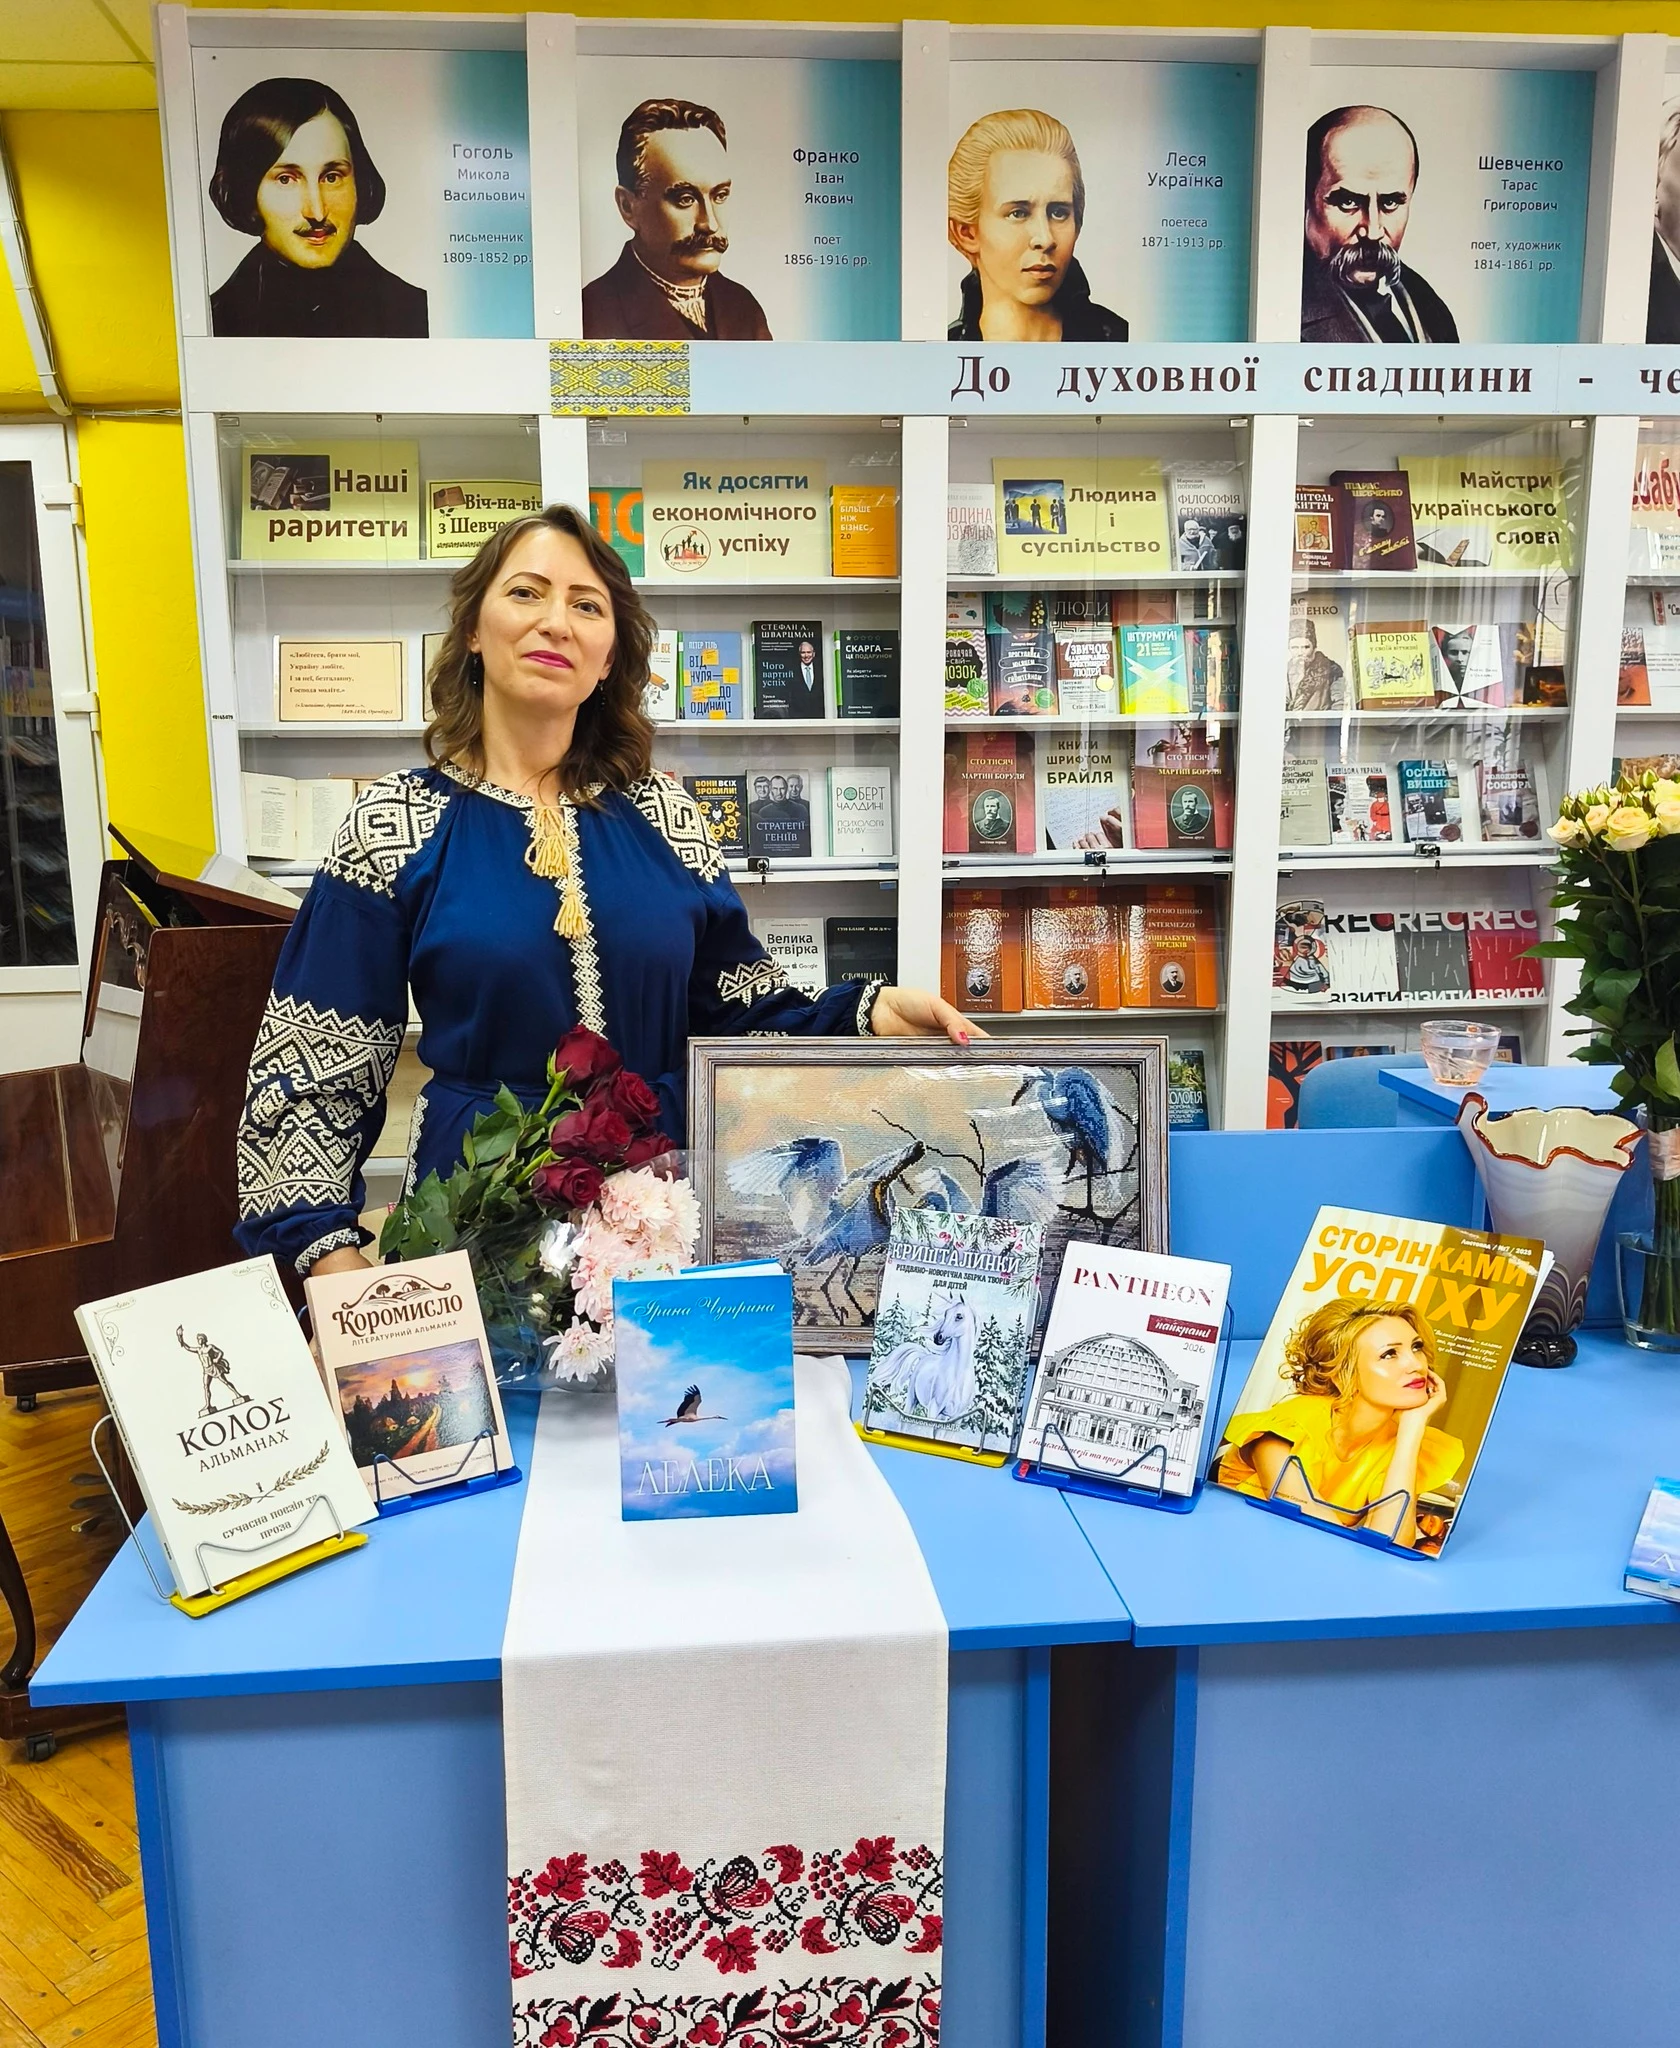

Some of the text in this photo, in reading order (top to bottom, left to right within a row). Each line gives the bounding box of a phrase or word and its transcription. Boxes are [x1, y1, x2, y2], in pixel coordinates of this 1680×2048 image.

[453, 144, 513, 159] Гоголь
[793, 148, 860, 166] Франко
[1165, 152, 1206, 167] Леся
[1479, 156, 1564, 171] Шевченко
[458, 168, 510, 180] Микола
[815, 172, 844, 184] Іван
[1147, 172, 1223, 190] Українка
[1501, 179, 1538, 192] Тарас
[444, 189, 526, 201] Васильович
[805, 192, 854, 204] Якович
[1484, 199, 1558, 212] Григорович
[1161, 219, 1208, 228] поетеса
[449, 233, 524, 242] письменник
[814, 236, 841, 245] поет
[1142, 237, 1227, 250] 1871-1913 рр.
[1471, 241, 1562, 252] поет, художник
[443, 252, 532, 265] 1809-1852 рр.
[784, 254, 871, 267] 1856-1916 рр.
[1474, 259, 1556, 272] 1814-1861 рр.
[951, 356, 1011, 402] До
[1057, 357, 1260, 403] духовної
[1304, 365, 1532, 398] спадщини
[333, 469, 408, 493] Наші
[683, 471, 809, 493] Як досягти
[1460, 471, 1553, 492] Майстри
[1069, 487, 1157, 504] Людина
[1177, 494, 1240, 504] ФІЛОСОФІЯ
[652, 503, 817, 522] економічного
[948, 507, 993, 524] ЮДИНА
[1412, 499, 1557, 520] українського
[1110, 514, 1115, 527] і
[268, 518, 408, 542] раритети
[439, 522, 446, 534] з
[1496, 529, 1560, 545] слова
[719, 533, 790, 556] успіху
[1021, 538, 1160, 557] суспільство
[1054, 601, 1109, 620] ЛЮДИ
[1291, 606, 1338, 616] ВЧЕНКО
[760, 623, 798, 631] СТЕФАН
[1127, 629, 1177, 642] ШТУРМУЙ!
[1369, 633, 1417, 645] Пророк
[946, 648, 973, 657] РОКАЧАЙ
[1071, 643, 1108, 654] ЗВИЧОК
[1136, 643, 1151, 657] 21
[762, 662, 784, 670] Чого
[691, 670, 712, 683] НУЛЯ
[762, 671, 794, 680] вартий
[762, 679, 786, 688] успіх
[719, 685, 732, 700] ДО
[690, 701, 731, 715] ОДИНИЦІ
[1058, 740, 1098, 750] КНИГИ
[970, 758, 1014, 766] СТО ТИСЯЧ
[1047, 755, 1112, 765] ШРИФТОМ
[962, 772, 1025, 780] МАРТИН БОРУЛЯ
[1047, 769, 1113, 784] БРАЙЛЯ
[1406, 768, 1447, 777] ОСТАП
[1407, 779, 1452, 789] ВИШНЯ
[1486, 781, 1531, 790] СОСЮРА
[695, 787, 737, 795] ЗРОБИЛИ!
[837, 786, 886, 801] РОБЕРТ
[837, 802, 884, 811] ЧАЛДИНІ
[756, 820, 805, 830] СТРАТЕГІЇ
[765, 832, 798, 841] ГЕНІЇВ
[1394, 911, 1465, 933] REC
[1468, 910, 1537, 931] REC
[767, 933, 813, 944] Велика
[1169, 1091, 1203, 1104] ОЛОГІЯ
[892, 1242, 1021, 1274] КРИШТАЛИНКИ
[1319, 1225, 1528, 1287] СТОРІНКАМИ
[933, 1279, 968, 1290] ДЛЯ ДІТЕЙ
[963, 1272, 986, 1283] ЗБІРКА
[987, 1276, 1010, 1286] ТВОРІВ
[1073, 1267, 1215, 1307] PANTHEON
[1303, 1252, 1520, 1332] УСПІХУ
[332, 1294, 463, 1336] Коромисло
[633, 1296, 776, 1323] Ірина Чуприна
[352, 1320, 458, 1347] ЛІТЕРАТУРНИЙ АЛЬМАНАХ
[1182, 1342, 1205, 1354] 2026
[200, 1429, 289, 1472] АЛЬМАНАХ
[636, 1456, 775, 1496] ЛЕЛЕКА
[222, 1500, 305, 1539] сучасна поезія
[260, 1521, 292, 1540] проза
